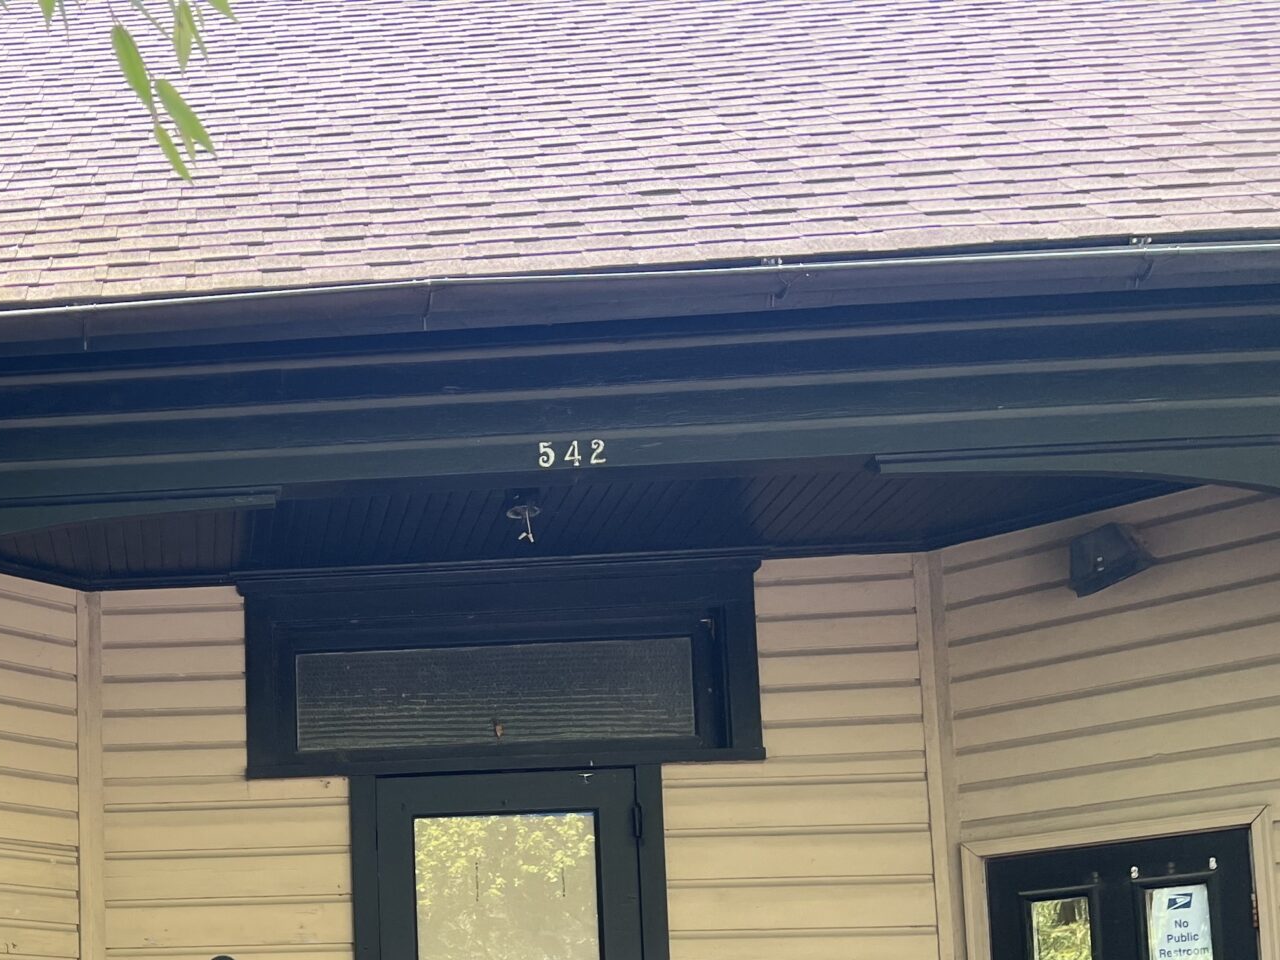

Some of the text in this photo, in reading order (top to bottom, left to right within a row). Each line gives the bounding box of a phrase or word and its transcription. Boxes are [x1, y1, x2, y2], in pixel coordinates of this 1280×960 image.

[538, 439, 607, 468] 542
[1174, 919, 1189, 929] No
[1166, 932, 1199, 943] Public
[1159, 946, 1210, 958] Restroom
